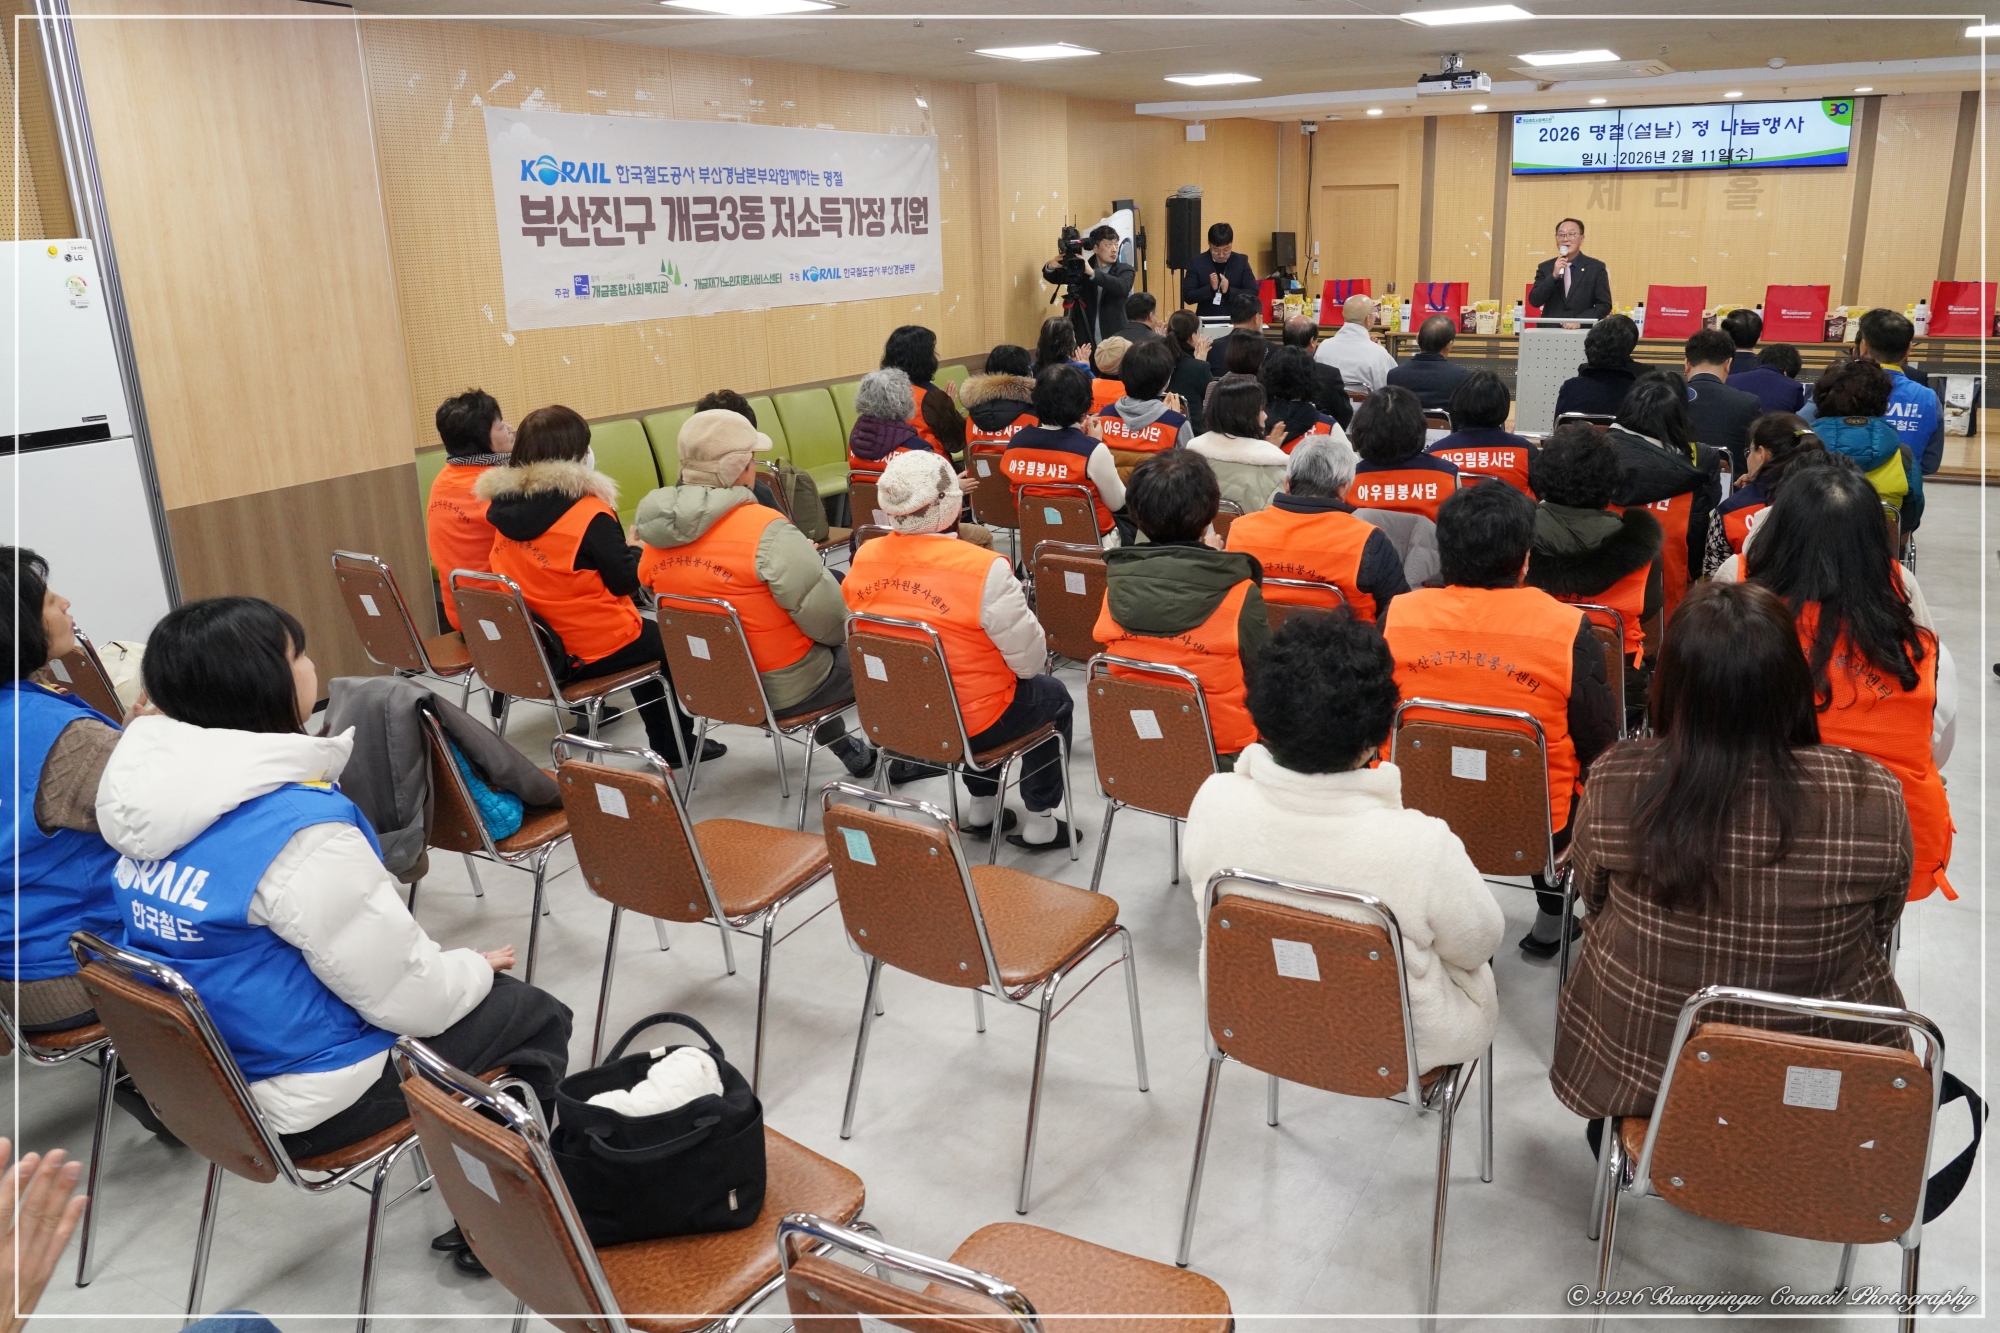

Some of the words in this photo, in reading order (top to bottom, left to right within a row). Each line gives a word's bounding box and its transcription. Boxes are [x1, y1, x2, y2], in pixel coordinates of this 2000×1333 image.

[1539, 126, 1580, 143] 2026
[1589, 121, 1682, 141] 명절(설날)
[1691, 119, 1710, 138] 정
[1721, 116, 1805, 136] 나눔행사
[1581, 152, 1607, 166] 일시
[1619, 150, 1666, 165] 2026년
[1671, 149, 1694, 163] 2월
[1701, 147, 1754, 162] 11일(수)
[520, 154, 612, 186] KORAIL
[615, 164, 696, 186] 한국철도공사
[698, 166, 820, 187] 부산경남본부와함께하는
[823, 170, 844, 187] 명절
[519, 194, 657, 248] 부산진구
[660, 195, 766, 243] 개금3동
[769, 196, 886, 239] 저소득가정
[890, 196, 929, 236] 지원
[802, 266, 842, 283] KORAIL
[843, 266, 881, 279] 한국철도공사
[881, 263, 916, 276] 부산경남본부
[554, 288, 570, 299] 주관
[591, 281, 669, 299] 개금종합사회복지관
[1885, 402, 1923, 419] AIL
[1008, 459, 1069, 479] 아우림봉사단
[1357, 482, 1438, 501] 아우림봉사단
[649, 555, 733, 583] 산진구자원봉사센터
[856, 577, 951, 615] 부산진구자원봉사센터
[1406, 650, 1541, 694] 부산진구자원봉사센터
[131, 899, 205, 942] 한국철도
